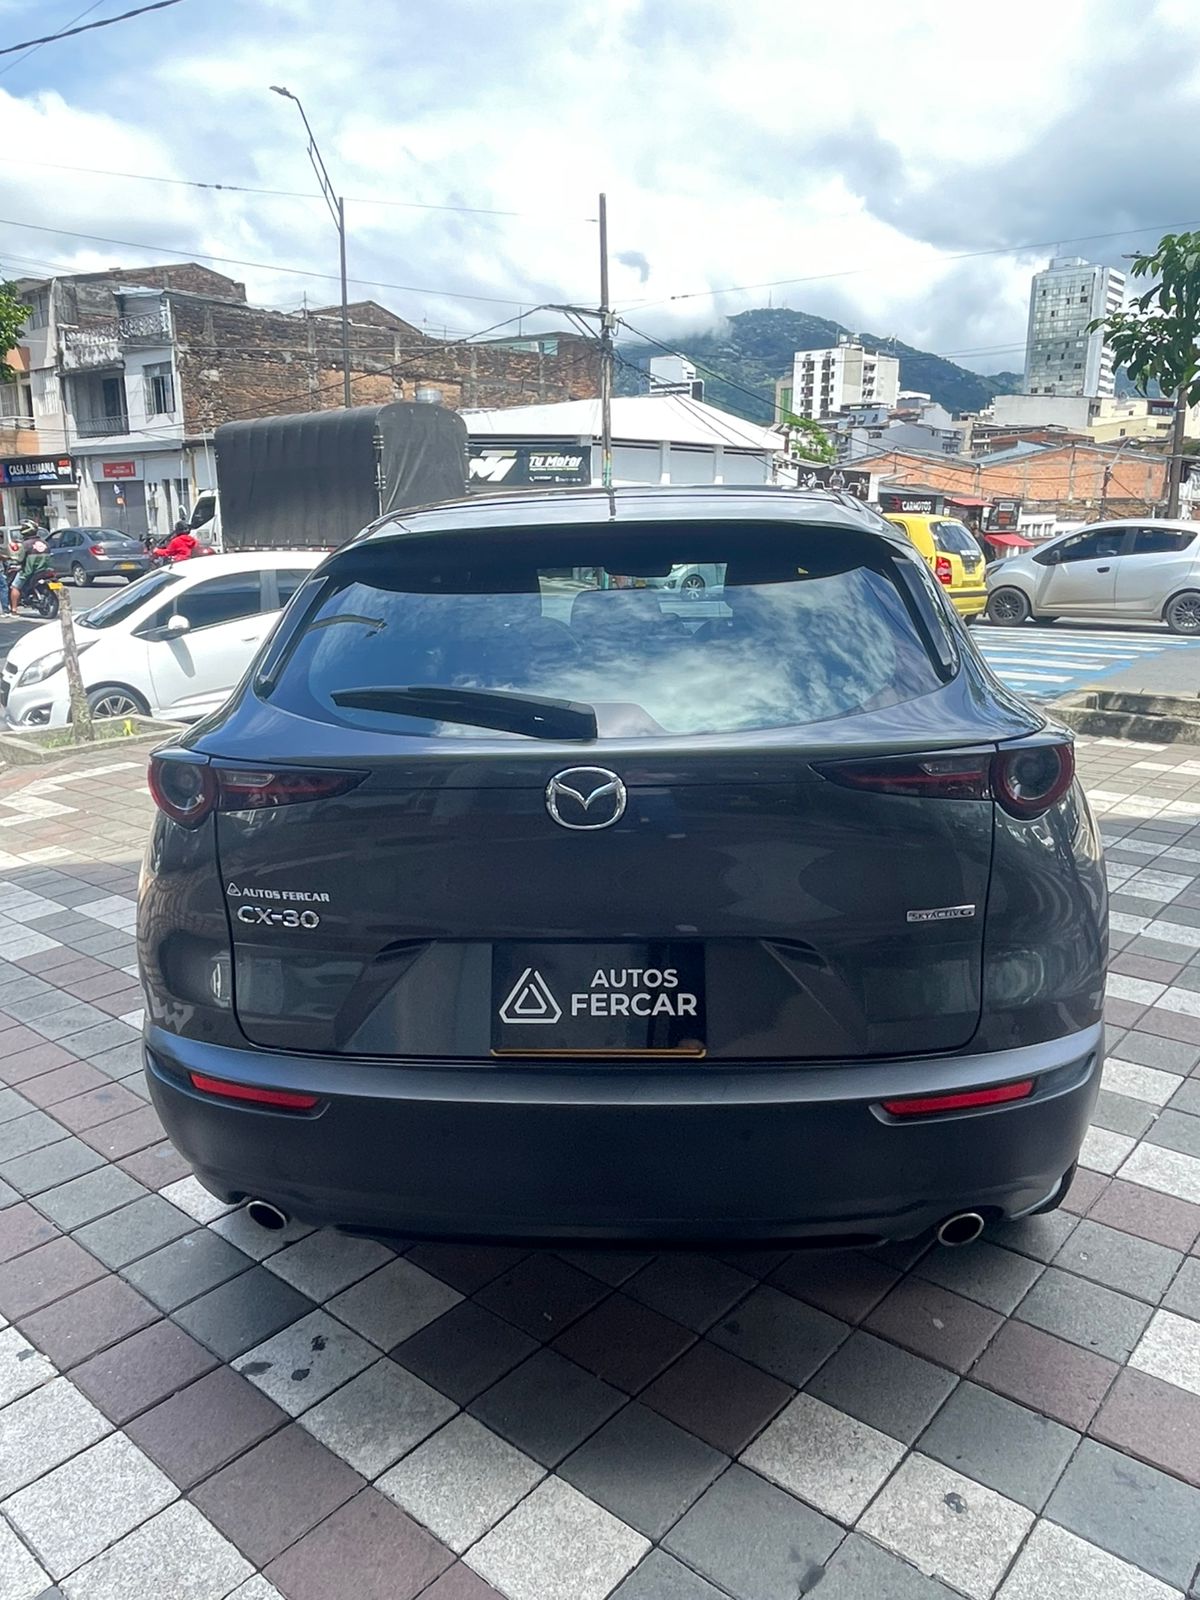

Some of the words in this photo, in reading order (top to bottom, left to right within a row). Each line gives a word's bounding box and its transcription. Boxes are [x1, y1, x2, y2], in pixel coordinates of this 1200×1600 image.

[8, 464, 25, 476] CASA
[25, 462, 56, 474] ALEMANA
[544, 455, 583, 468] Motor
[242, 887, 281, 900] AUTOS
[282, 890, 331, 903] FERCAR
[236, 905, 320, 930] CX-30
[590, 968, 679, 989] AUTOS
[571, 992, 698, 1017] FERCAR
